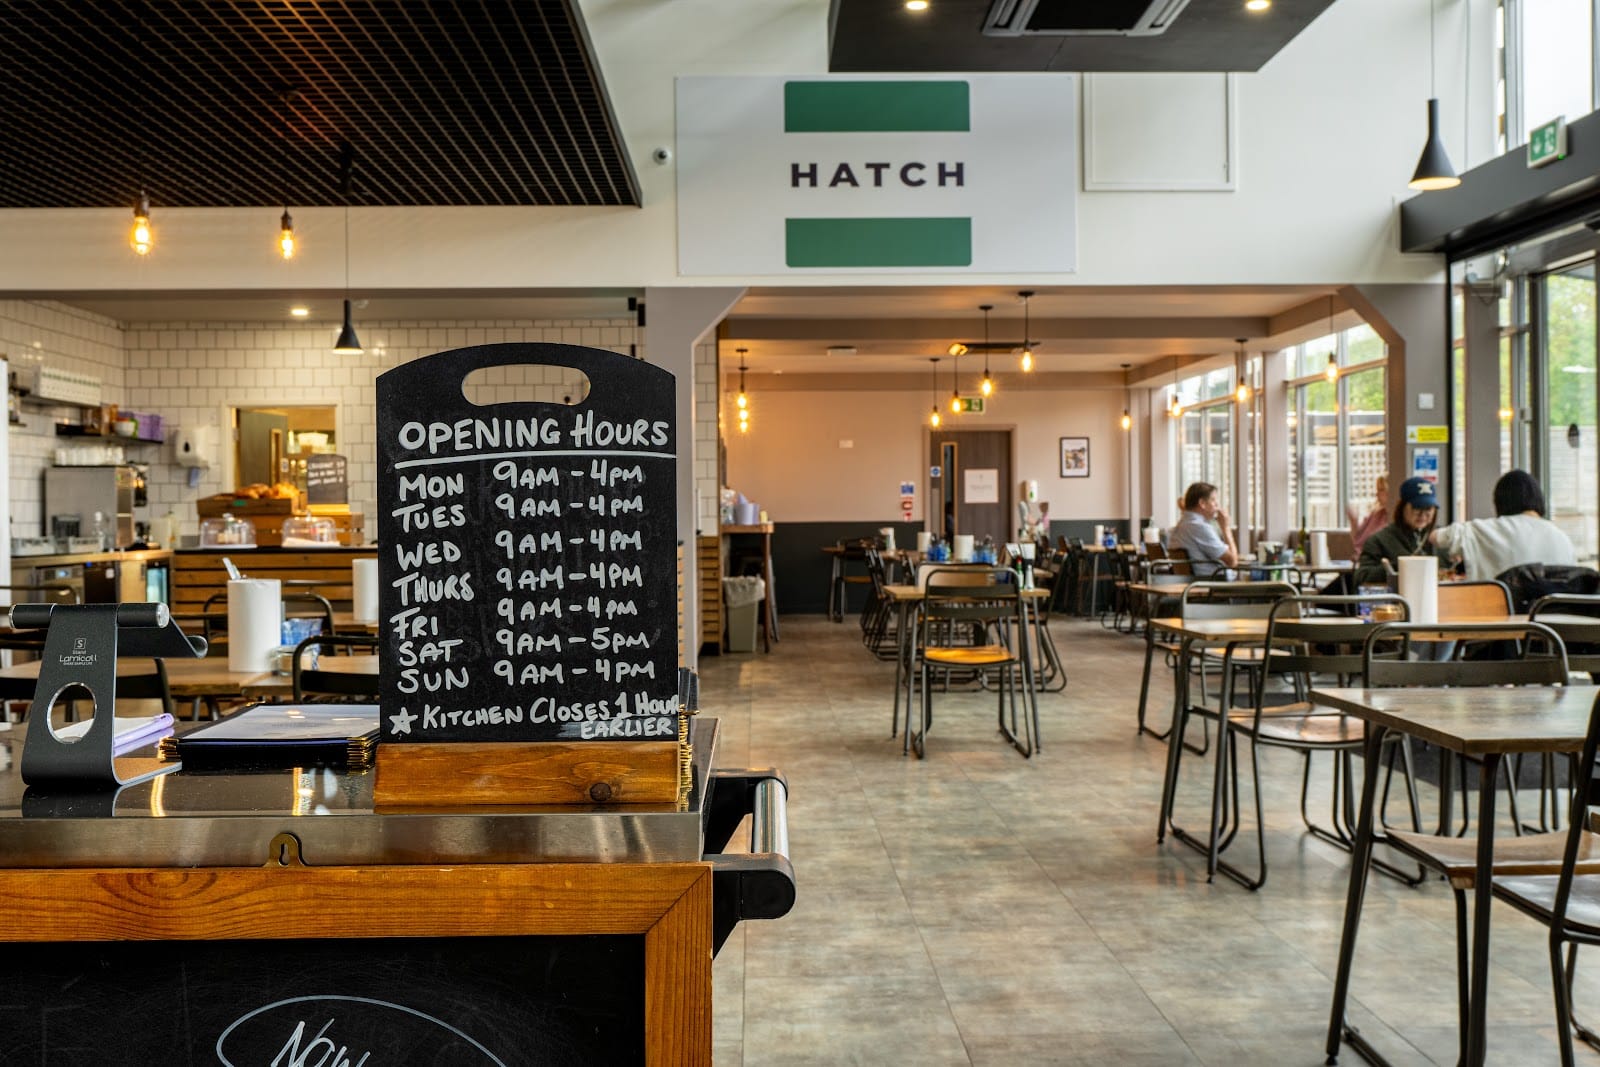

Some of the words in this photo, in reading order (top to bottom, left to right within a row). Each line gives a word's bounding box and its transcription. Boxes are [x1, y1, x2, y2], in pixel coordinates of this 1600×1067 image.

[790, 161, 966, 188] HATCH
[398, 417, 562, 456] OPENING
[569, 409, 670, 449] HOURS
[399, 473, 464, 502] MON
[492, 460, 560, 490] 9AM
[590, 459, 643, 488] 4PM
[391, 502, 467, 533] TUES
[494, 493, 561, 519] 9AM
[588, 494, 643, 517] 4PM
[396, 540, 461, 571] WED
[494, 530, 563, 559] 9AM
[590, 528, 642, 551] 4PM
[392, 571, 475, 606] THURS
[496, 565, 564, 591] 9AM
[589, 561, 643, 589] 4PM
[389, 606, 439, 639] FRI
[497, 597, 562, 625] 9AM
[587, 596, 638, 620] 4PM
[398, 638, 464, 667] SAT
[495, 628, 562, 656] 9AM
[591, 626, 650, 654] 5PM
[397, 666, 469, 694] SUN
[493, 659, 564, 686] 9AM
[595, 658, 655, 683] 4PM
[422, 704, 523, 729] KITCHEN
[529, 697, 610, 723] CLOSES
[614, 691, 632, 719] 1
[634, 690, 679, 716] HOUR
[580, 717, 674, 740] EARLIER
